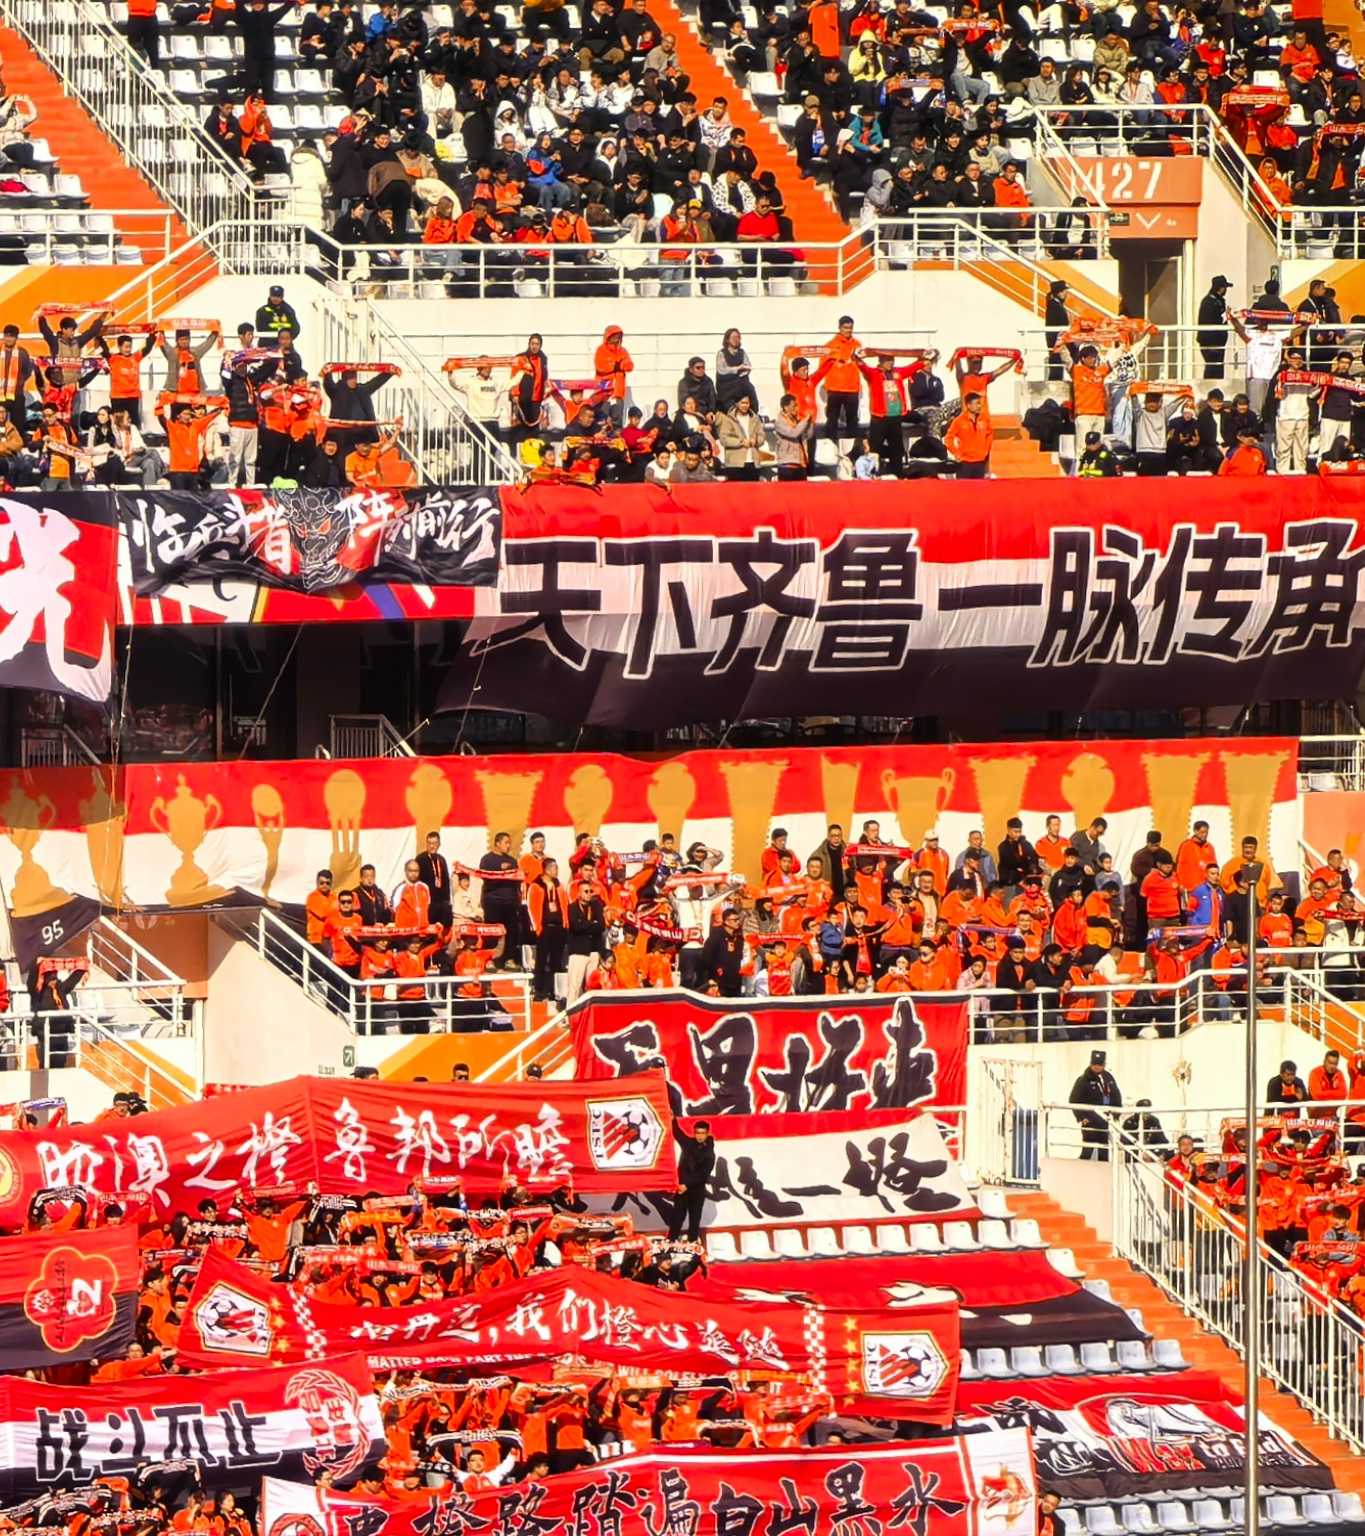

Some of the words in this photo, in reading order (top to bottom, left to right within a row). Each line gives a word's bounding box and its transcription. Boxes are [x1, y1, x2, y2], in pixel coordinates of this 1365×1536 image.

[468, 519, 1365, 679] 天下齐鲁一脉传承
[42, 922, 65, 945] 95
[34, 1391, 285, 1484] 战斗不止
